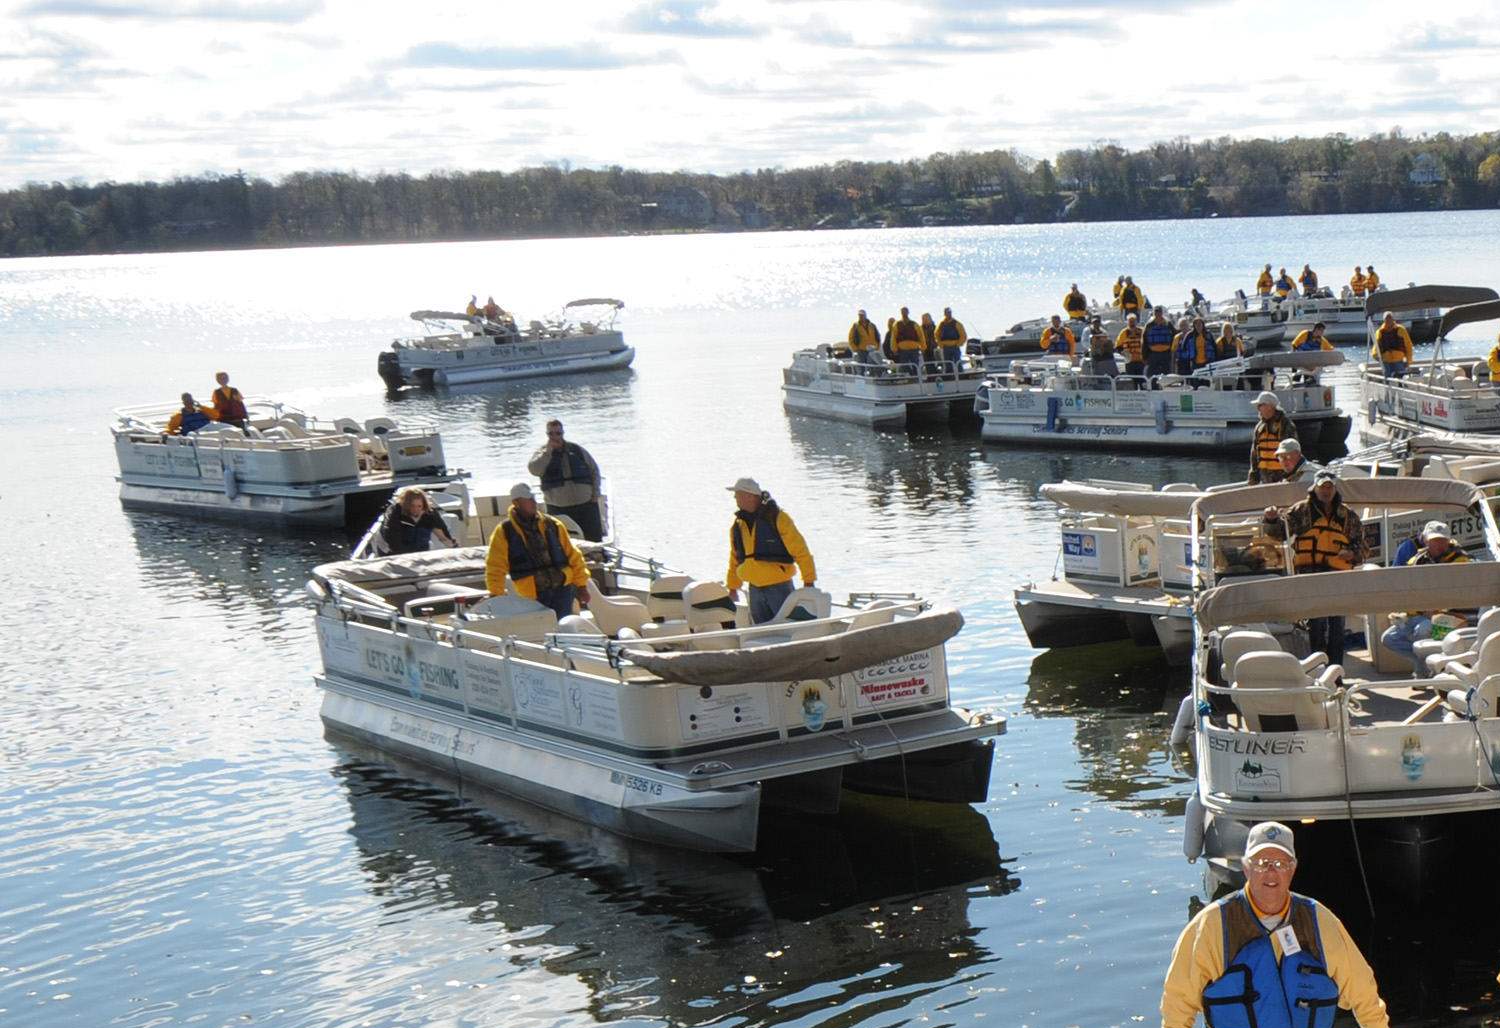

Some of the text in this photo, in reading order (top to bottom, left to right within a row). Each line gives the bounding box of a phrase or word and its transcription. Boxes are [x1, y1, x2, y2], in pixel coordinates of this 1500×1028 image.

[902, 652, 929, 664] MARINA
[366, 649, 460, 690] LET'S GO FISHING
[871, 694, 886, 702] BAIT
[894, 688, 916, 698] TACKLE
